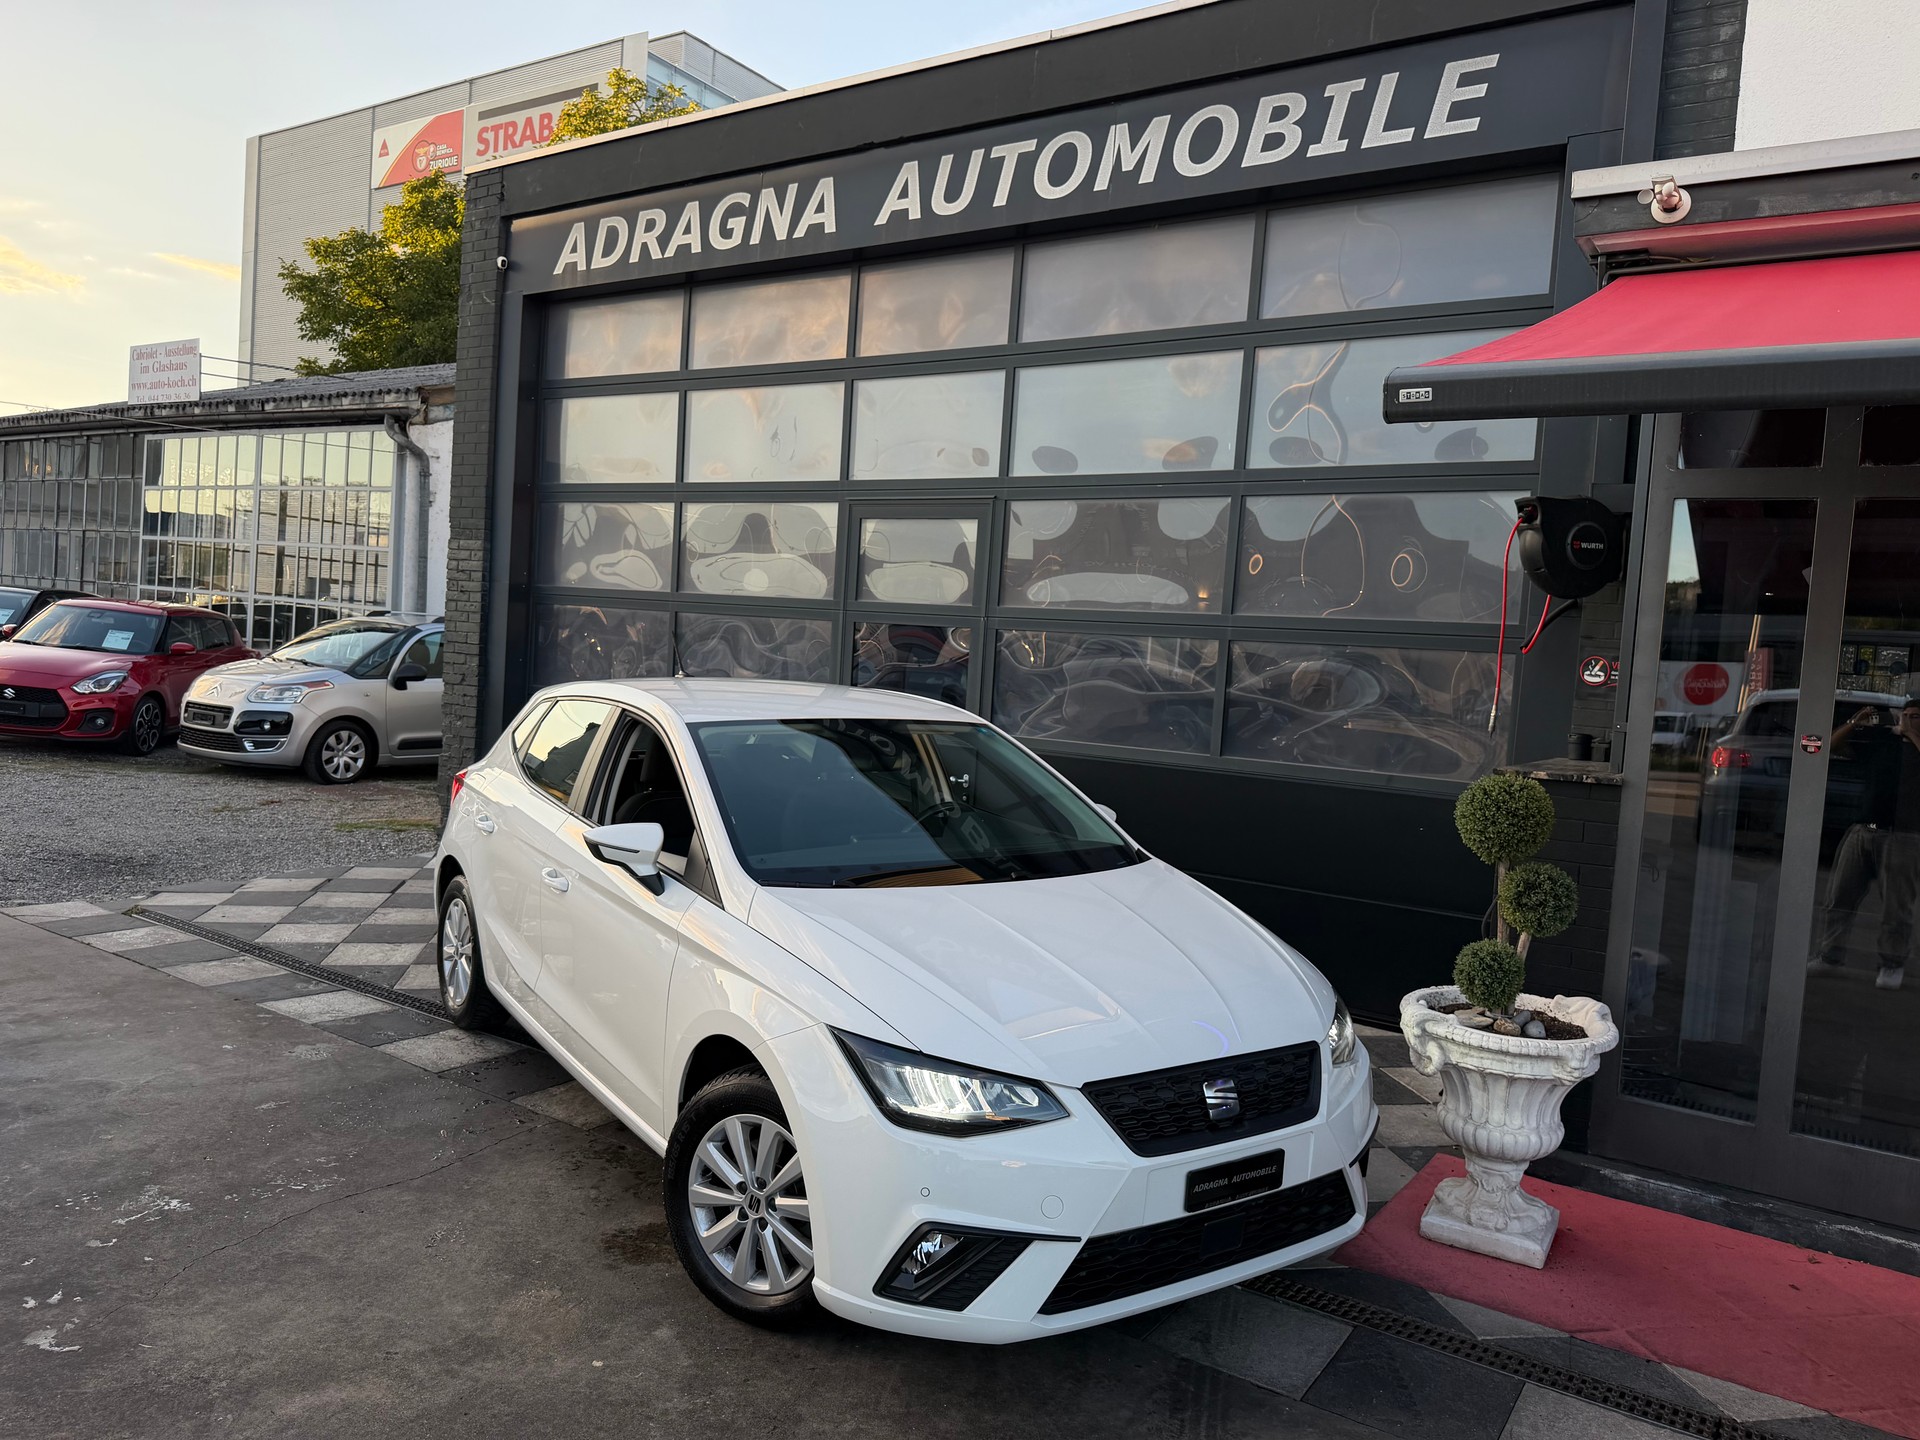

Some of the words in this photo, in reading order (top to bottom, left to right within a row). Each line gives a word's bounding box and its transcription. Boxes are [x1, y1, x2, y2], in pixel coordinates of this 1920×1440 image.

[429, 156, 458, 170] ZURIQUE
[553, 177, 836, 275] ADRAGNA
[874, 53, 1500, 226] AUTOMOBILE
[132, 347, 158, 361] Cabriolet
[164, 343, 197, 358] Ausstellung
[140, 363, 149, 374] im
[152, 360, 188, 373] Glashaus
[131, 375, 197, 390] www.auto-koch.ch
[161, 393, 172, 401] 730
[1193, 1178, 1229, 1193] ADRAGNA
[1231, 1165, 1277, 1183] AUTOMOBILE
